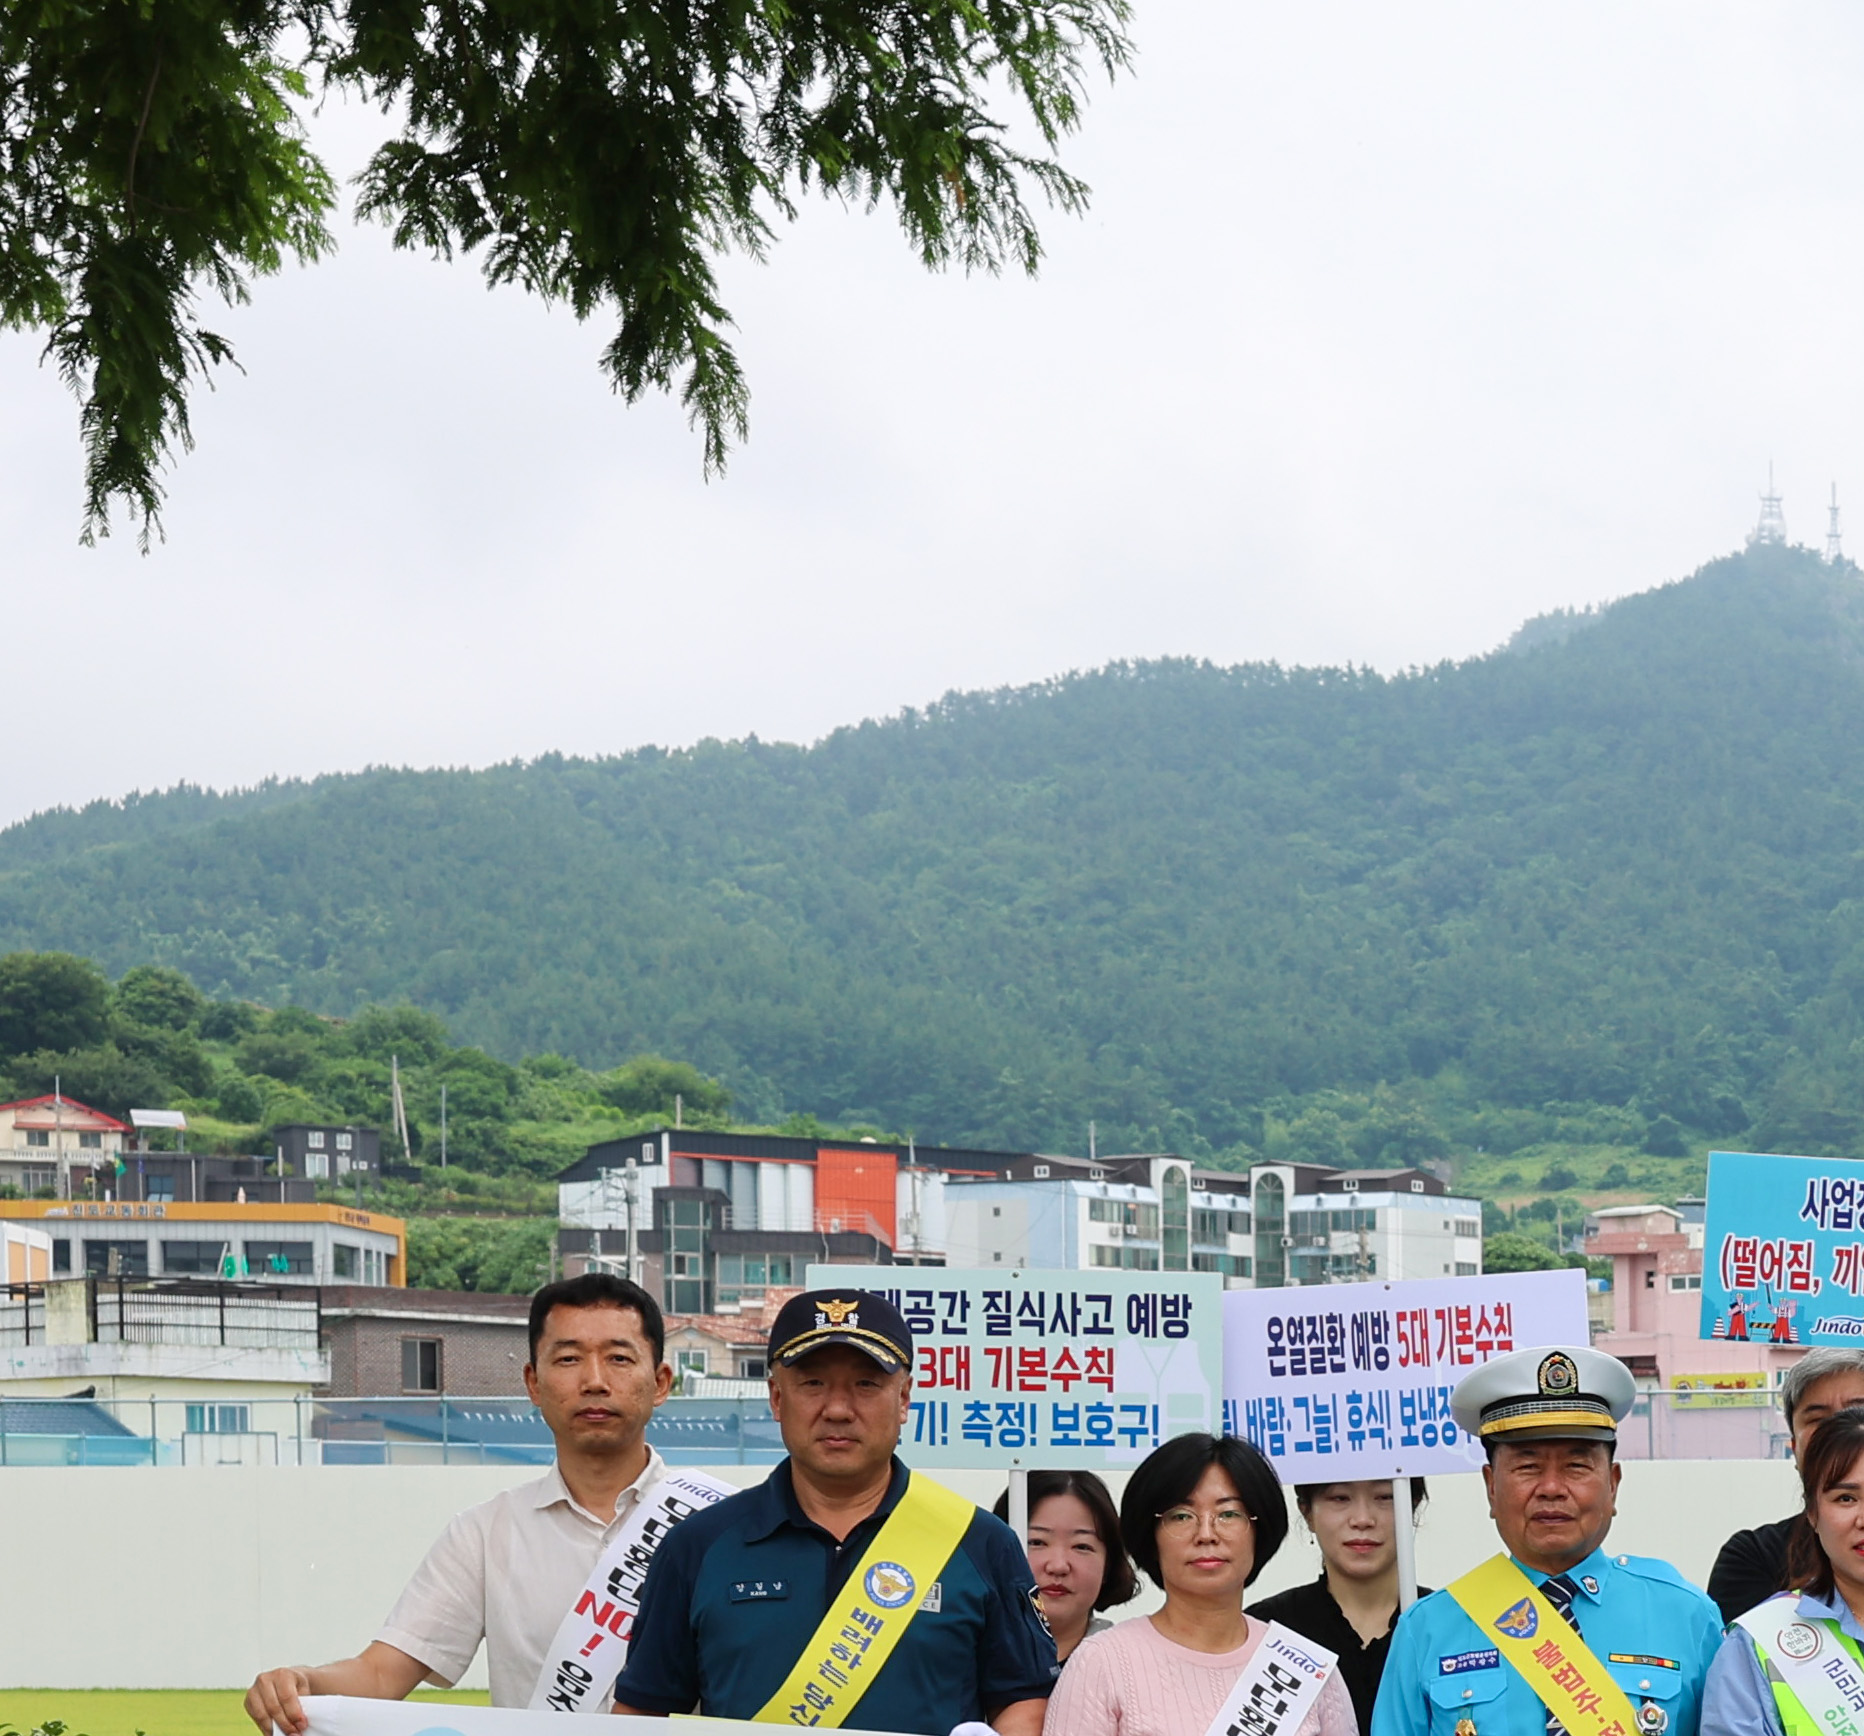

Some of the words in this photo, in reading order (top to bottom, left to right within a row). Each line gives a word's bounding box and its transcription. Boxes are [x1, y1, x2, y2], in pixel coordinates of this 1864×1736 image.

[1721, 1234, 1820, 1295] (떨어짐,
[982, 1290, 1115, 1338] 질식사고
[1127, 1293, 1193, 1339] 예방
[1266, 1312, 1347, 1377] 온열질환
[1351, 1310, 1391, 1371] 예방
[1396, 1308, 1431, 1368] 5대
[1435, 1302, 1514, 1367] 기본수칙
[917, 1346, 970, 1391] 3대
[985, 1346, 1116, 1393] 기본수칙
[898, 1400, 948, 1446] 기!
[961, 1400, 1036, 1449] 측정!
[1049, 1401, 1160, 1449] 보호구!
[1346, 1389, 1392, 1451] 휴식!
[817, 1606, 885, 1691] 배려하는
[1265, 1638, 1316, 1674] Jindo
